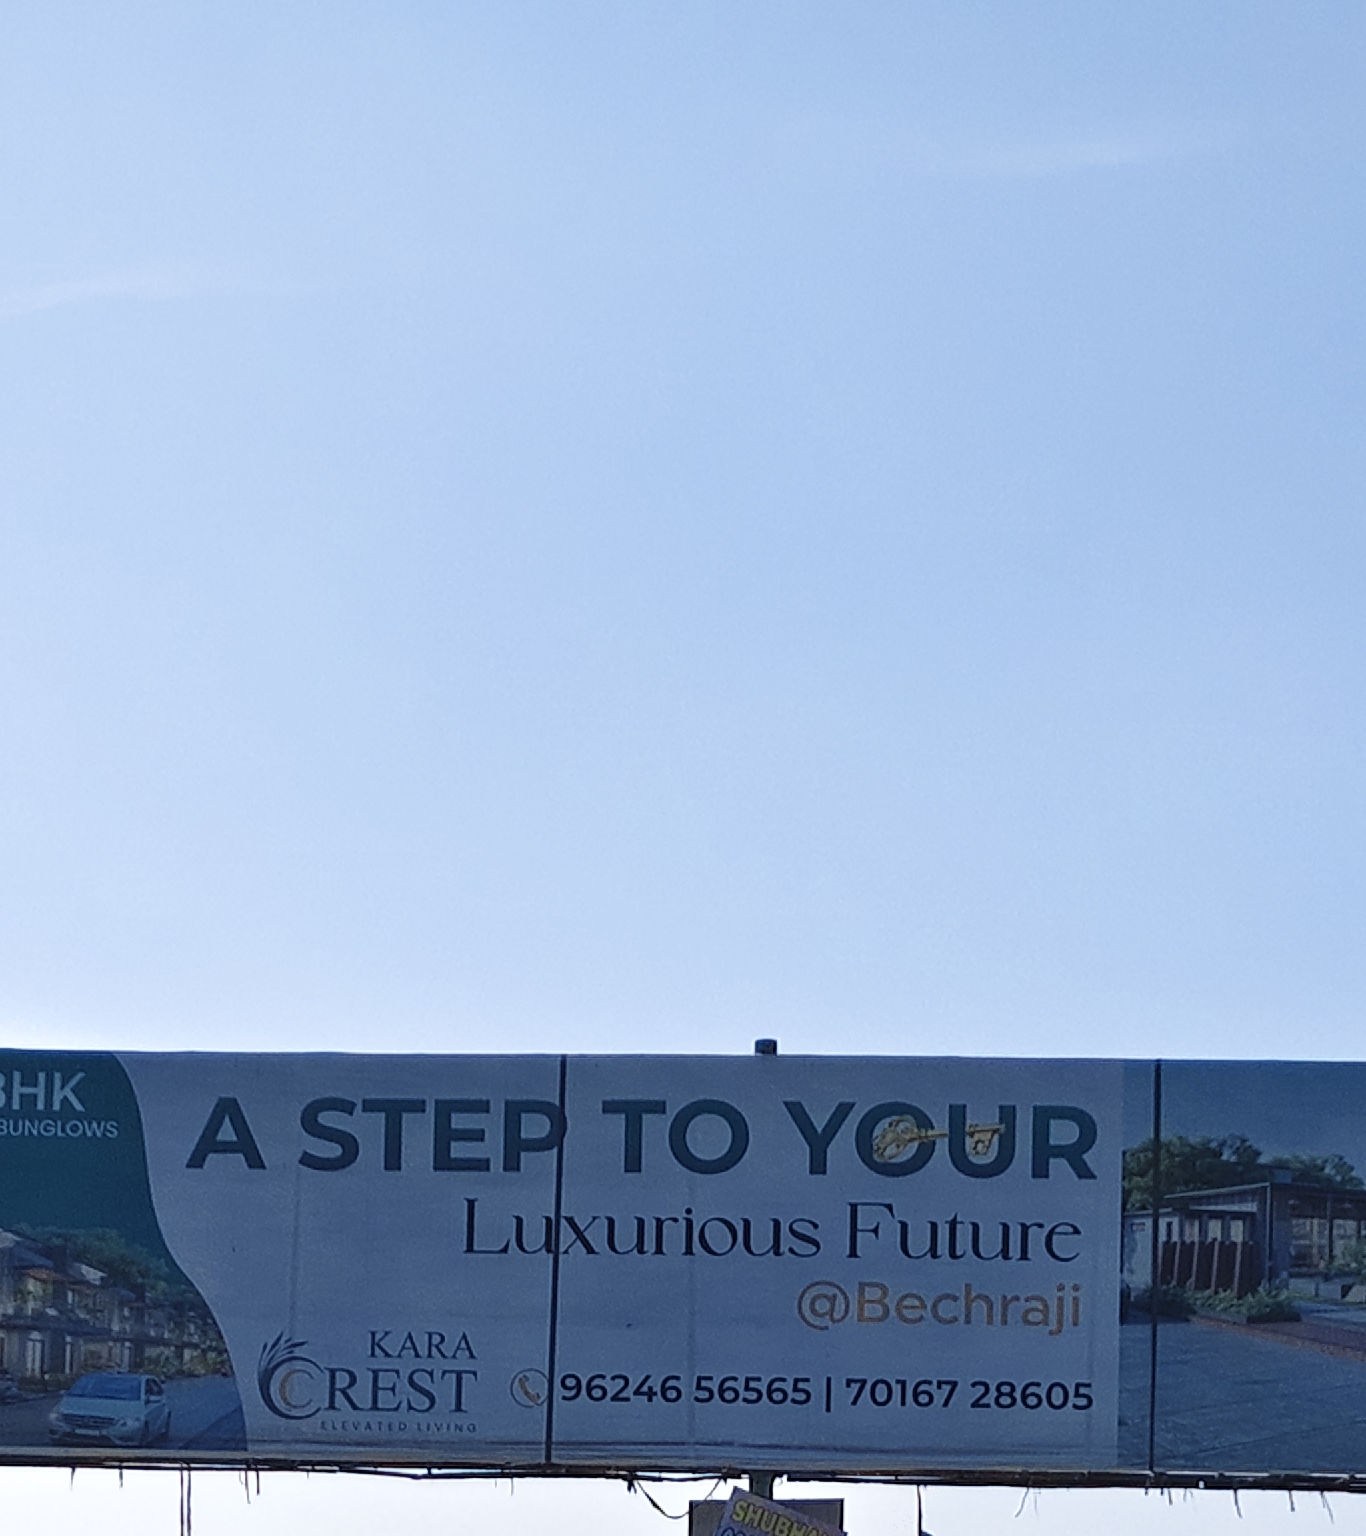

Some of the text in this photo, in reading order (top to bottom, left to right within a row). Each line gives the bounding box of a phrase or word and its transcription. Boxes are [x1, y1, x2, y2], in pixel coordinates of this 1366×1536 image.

[185, 1096, 1098, 1181] A STEP TO YOUR
[462, 1197, 1082, 1263] Luxurious Future
[797, 1281, 1082, 1335] @Bechraji
[368, 1330, 478, 1360] KARA
[258, 1354, 479, 1420] CREST
[560, 1373, 683, 1404] 96246
[694, 1374, 813, 1406] 56565
[845, 1376, 959, 1408] 70167
[969, 1379, 1094, 1411] 28605
[320, 1420, 477, 1434] ELEVATED LIVING
